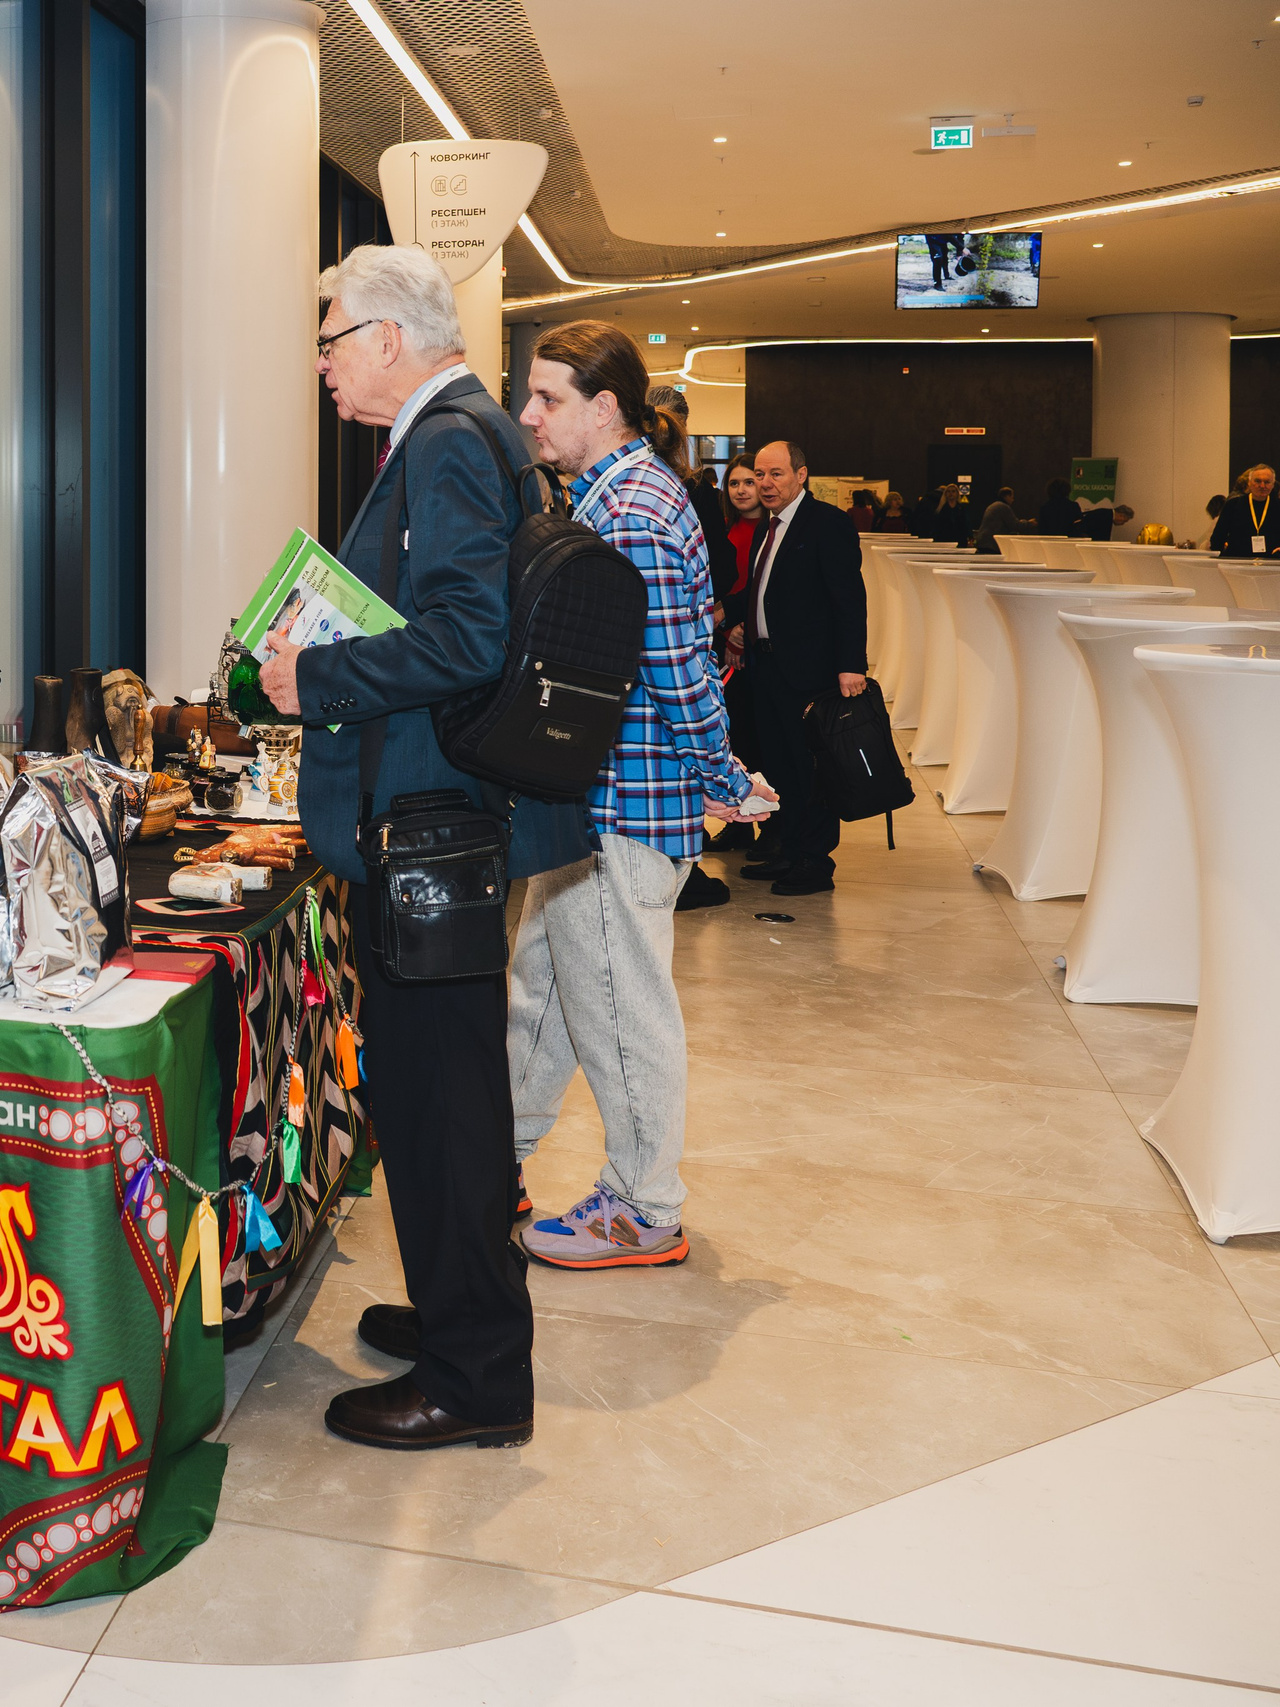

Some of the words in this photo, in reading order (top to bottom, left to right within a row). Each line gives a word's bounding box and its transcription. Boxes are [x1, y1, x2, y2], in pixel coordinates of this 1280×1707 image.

[430, 152, 491, 162] КОВОРКИНГ
[431, 208, 486, 217] РЕСЕПШЕН
[431, 219, 439, 229] (1
[440, 219, 469, 228] ЭТАЖ)
[431, 239, 485, 249] РЕСТОРАН
[440, 250, 469, 259] ЭТАЖ)
